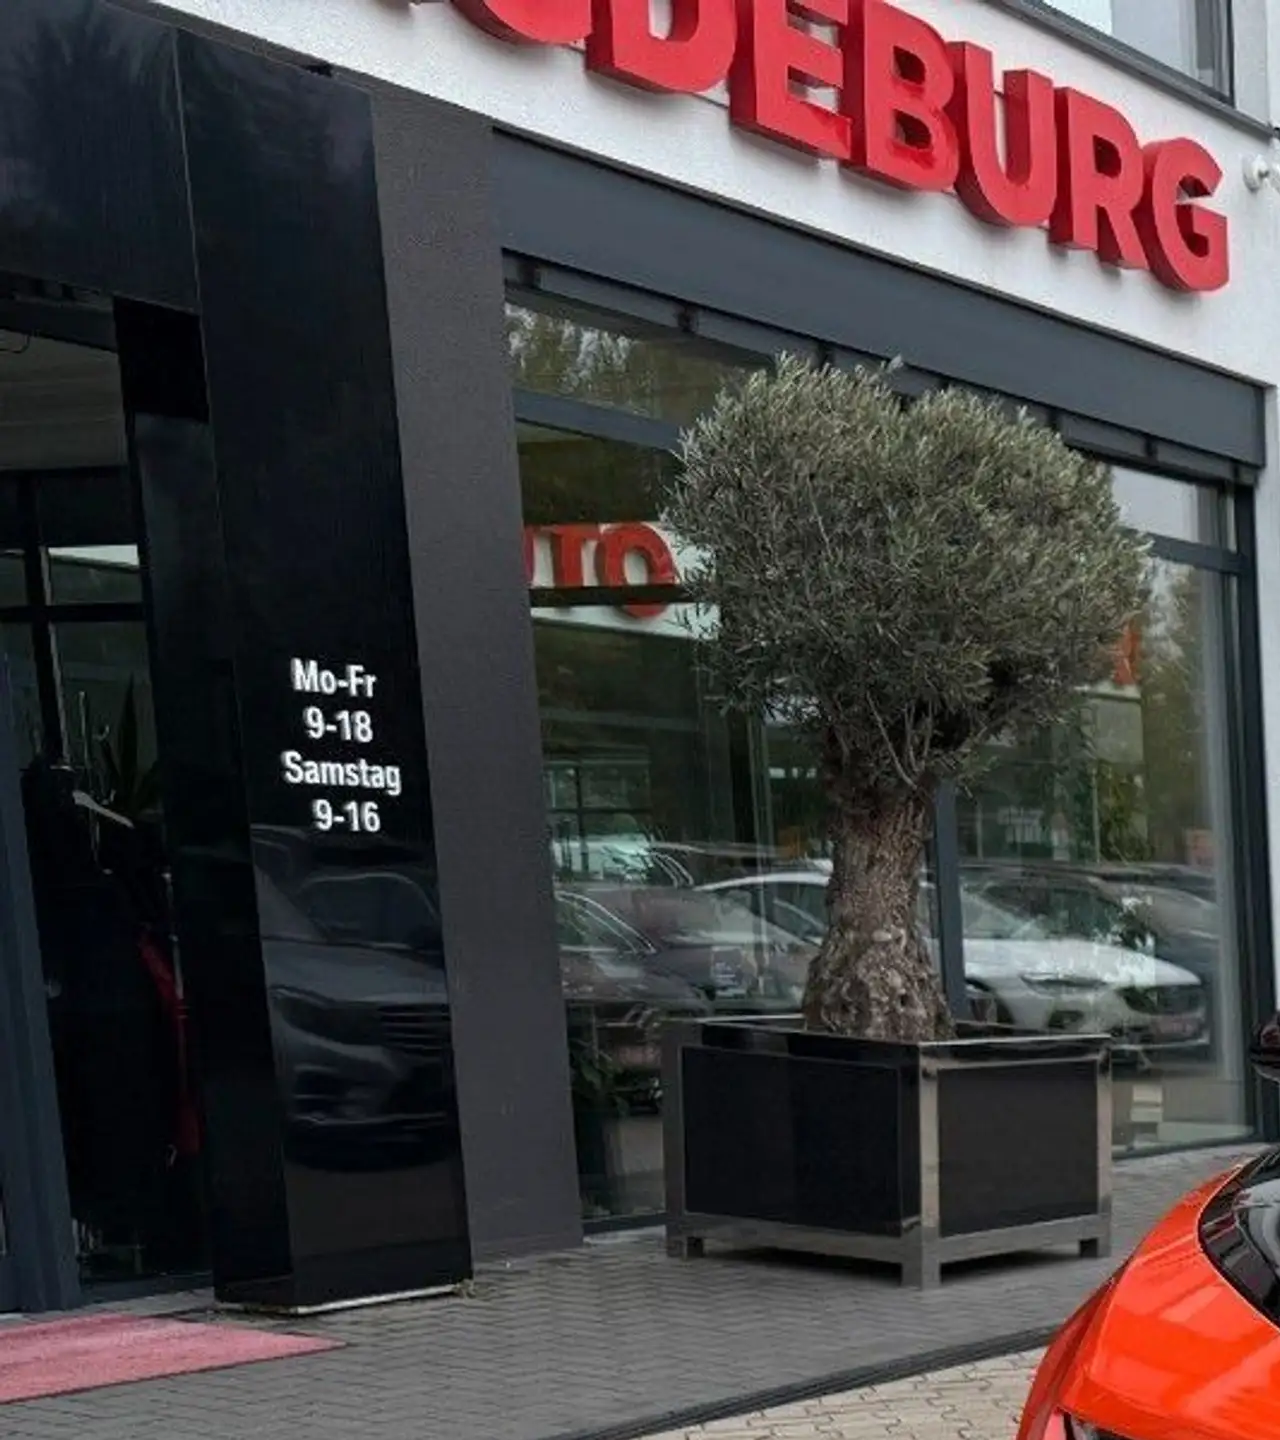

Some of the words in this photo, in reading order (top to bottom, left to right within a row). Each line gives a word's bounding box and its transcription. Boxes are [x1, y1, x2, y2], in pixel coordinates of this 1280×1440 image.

[291, 657, 377, 698] Mo-Fr
[303, 706, 374, 743] 9-18
[281, 750, 402, 796] Samstag
[312, 799, 381, 832] 9-16
